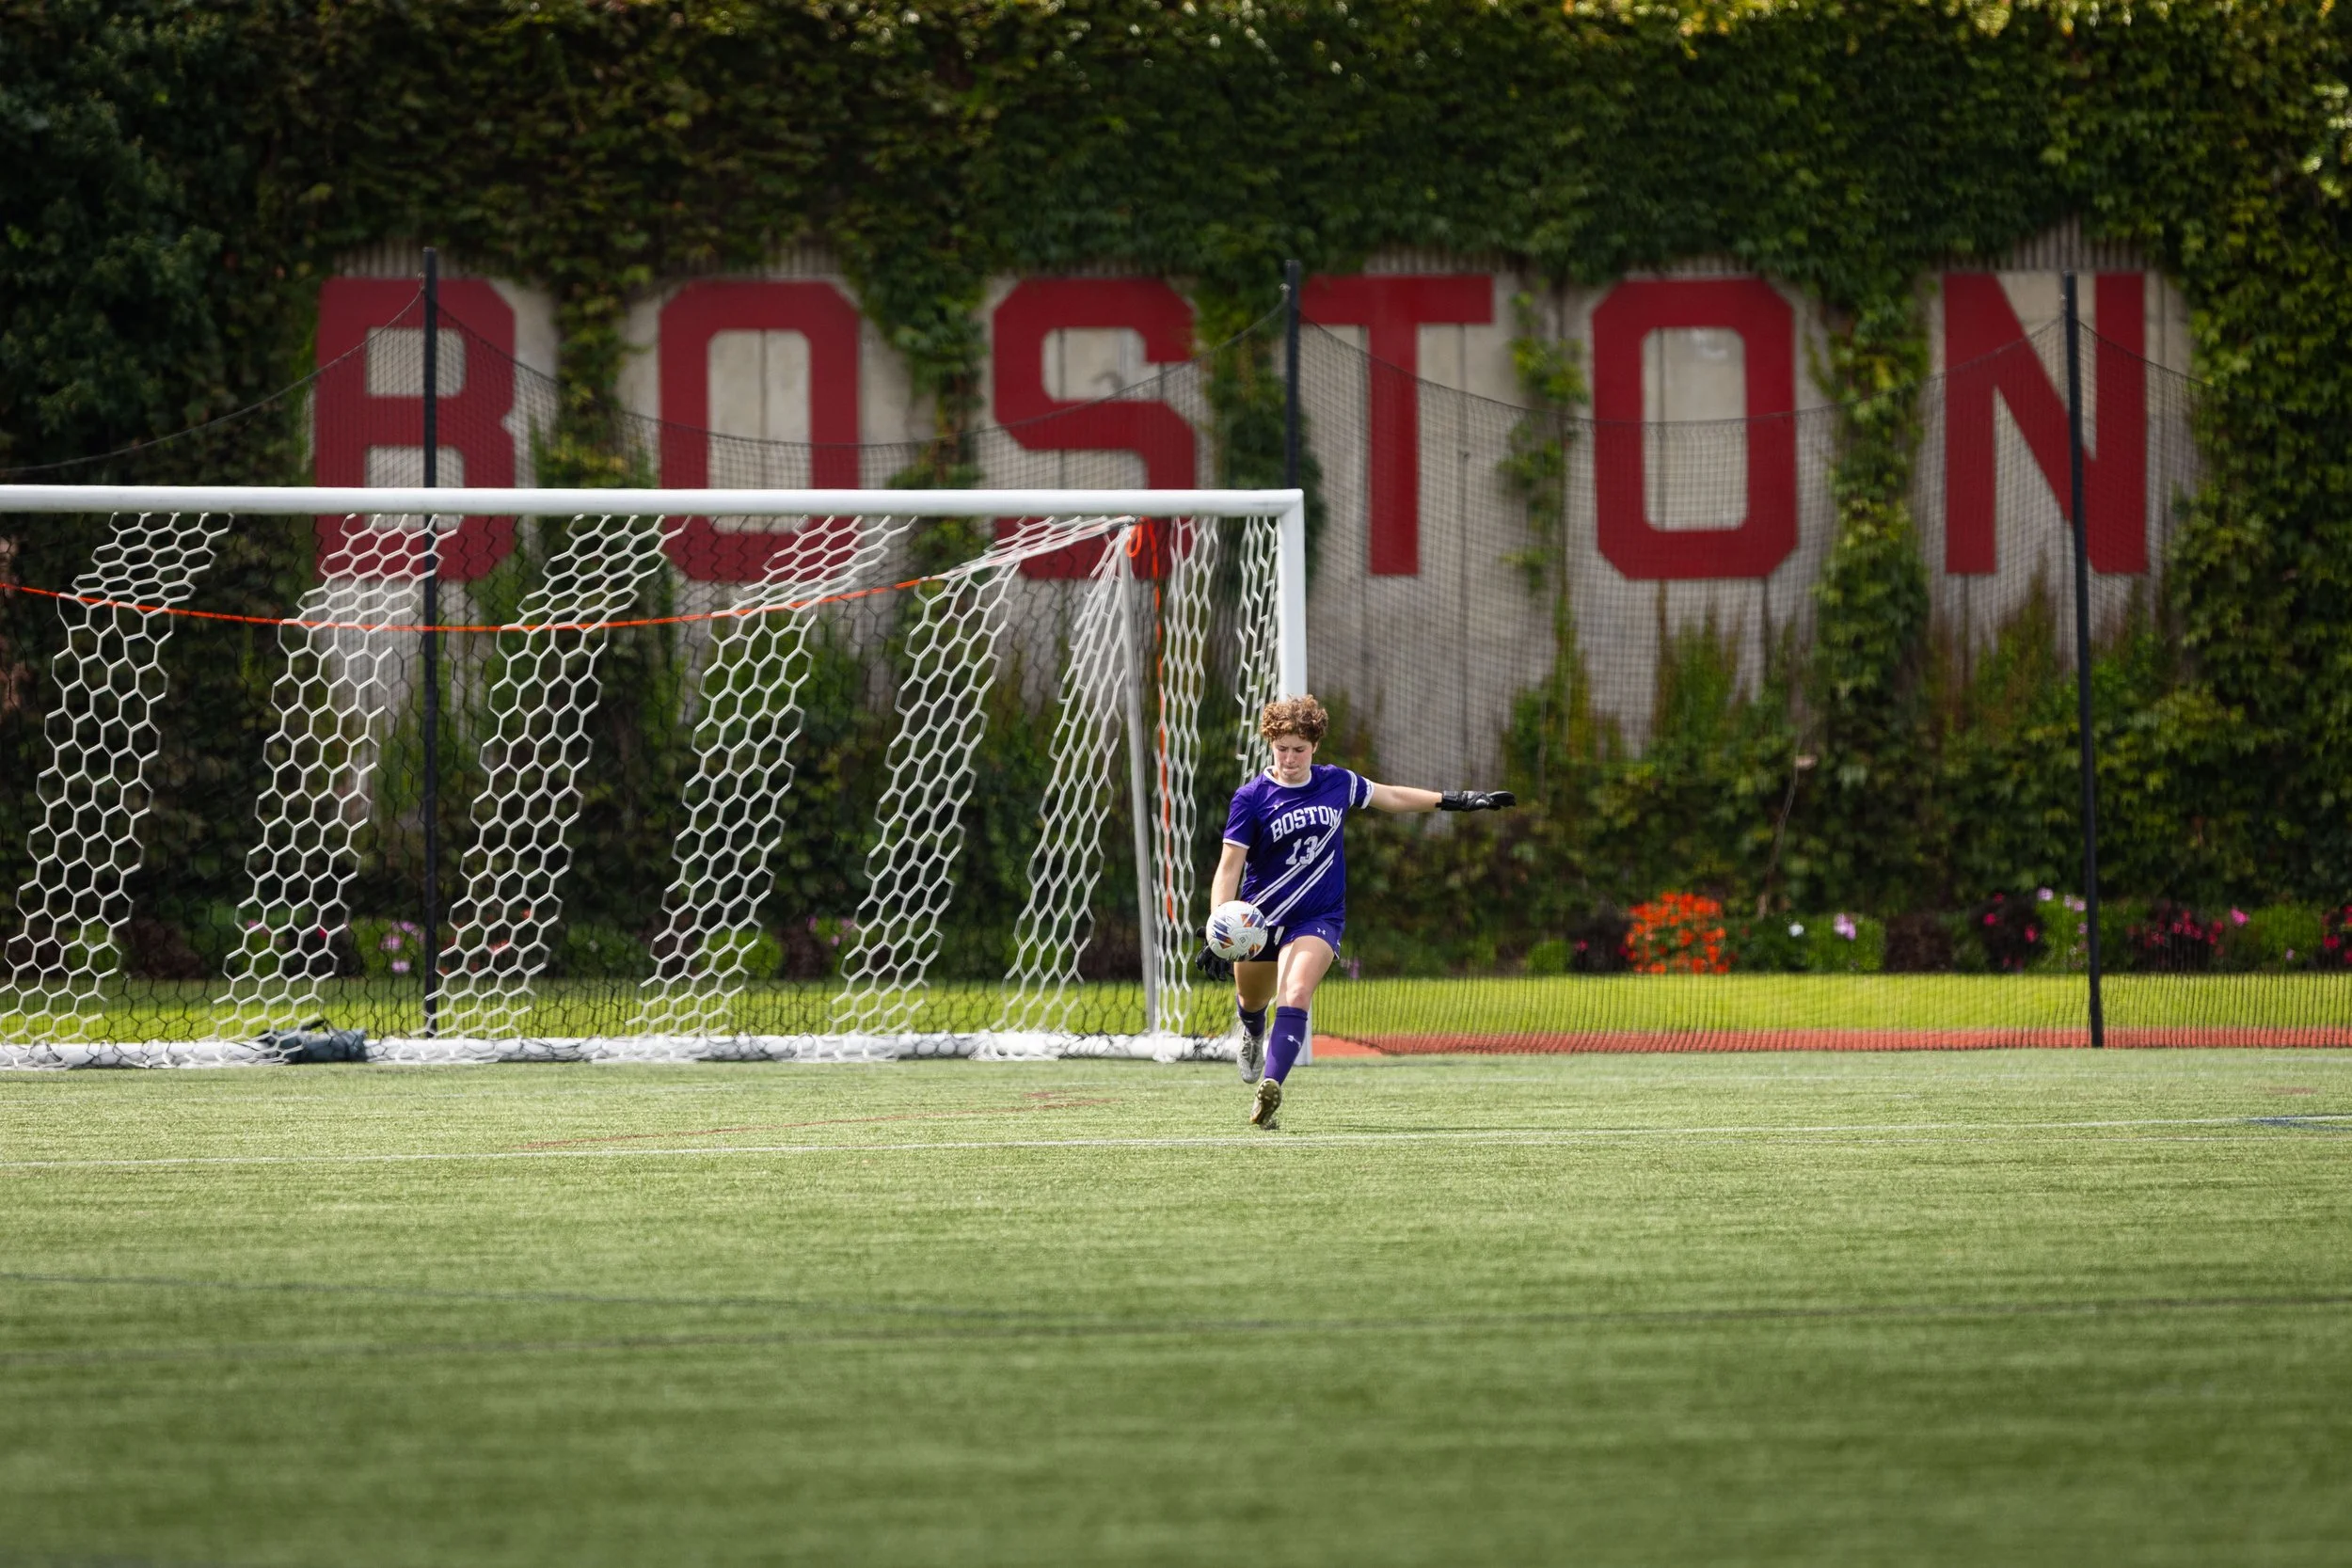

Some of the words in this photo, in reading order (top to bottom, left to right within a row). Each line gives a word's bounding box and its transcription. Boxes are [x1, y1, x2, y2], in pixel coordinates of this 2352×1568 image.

[314, 273, 2147, 580] BOSTON
[1270, 806, 1340, 843] BOSTON
[1285, 835, 1319, 865] 13
